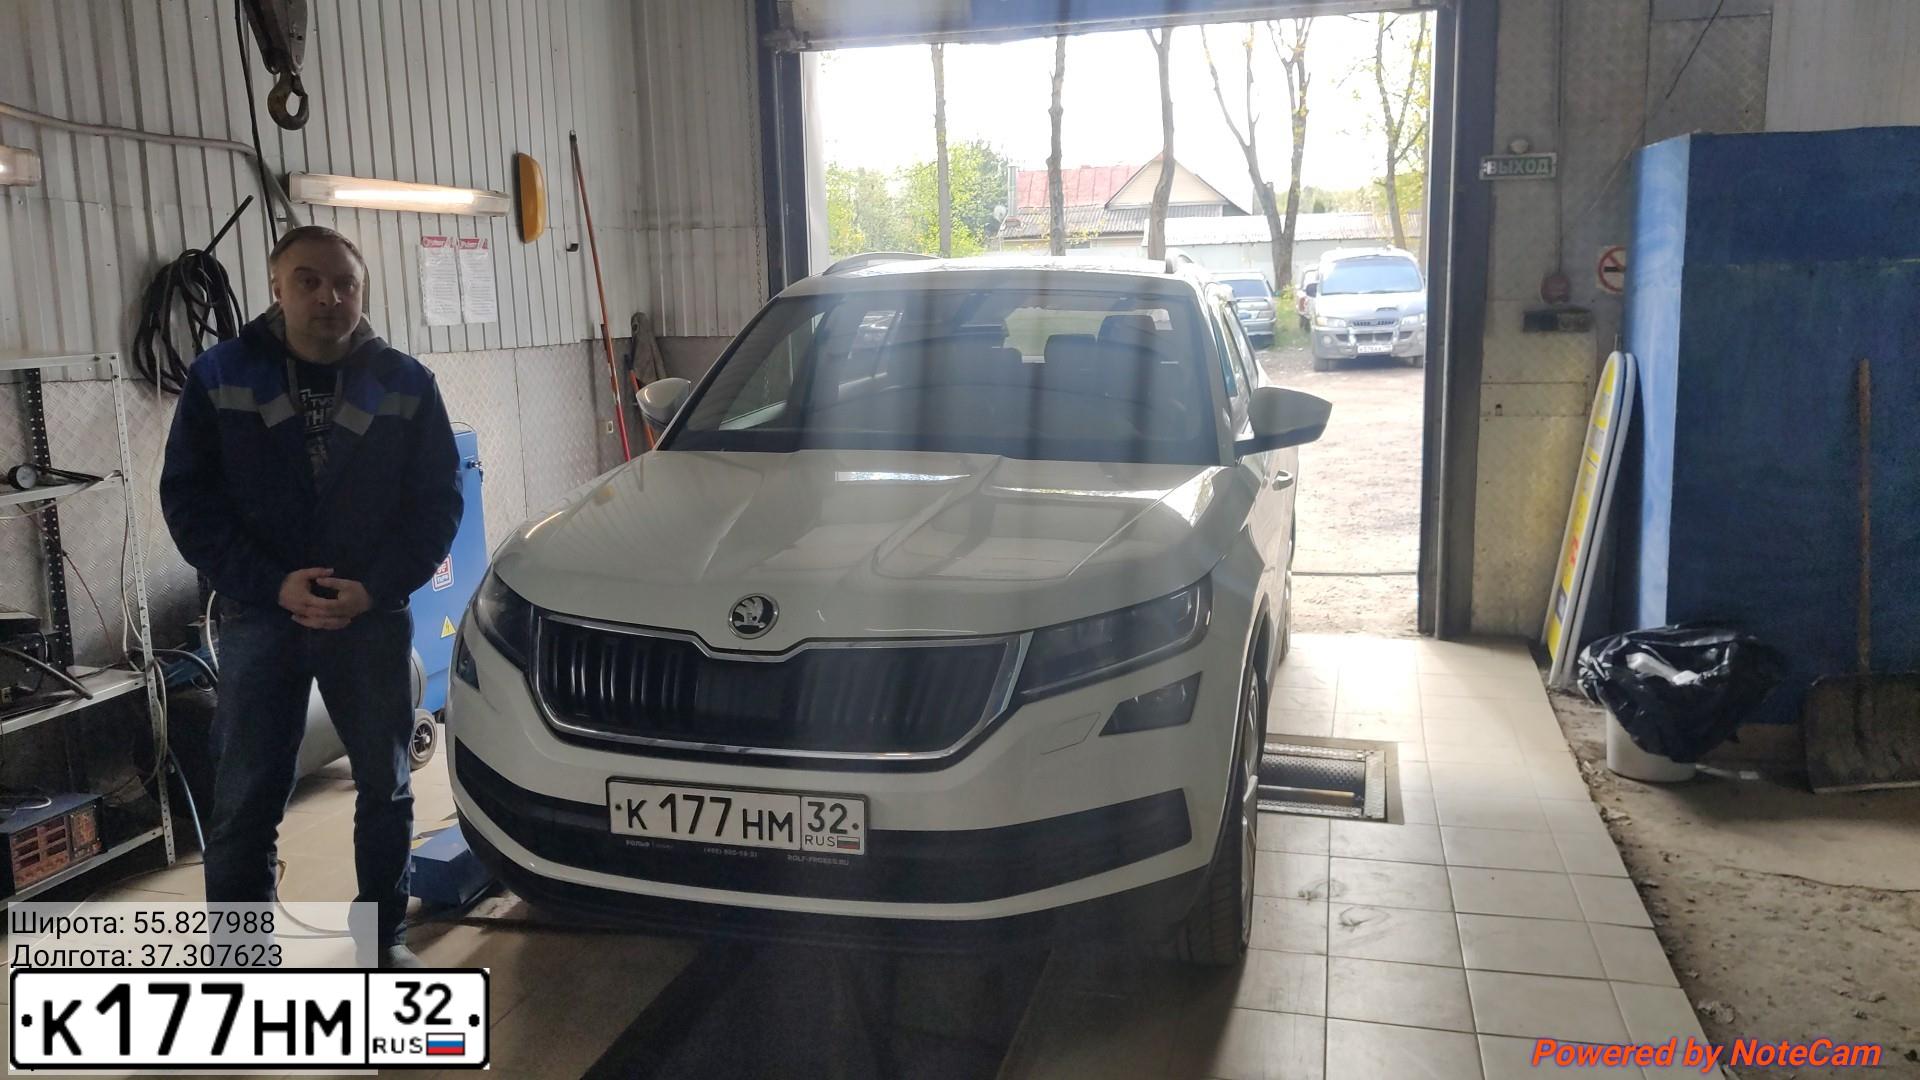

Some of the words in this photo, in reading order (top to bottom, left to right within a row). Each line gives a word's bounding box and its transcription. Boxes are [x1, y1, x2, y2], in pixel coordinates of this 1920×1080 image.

[1486, 158, 1550, 176] ВЫХОД
[806, 801, 849, 835] 32
[804, 834, 836, 848] RUS
